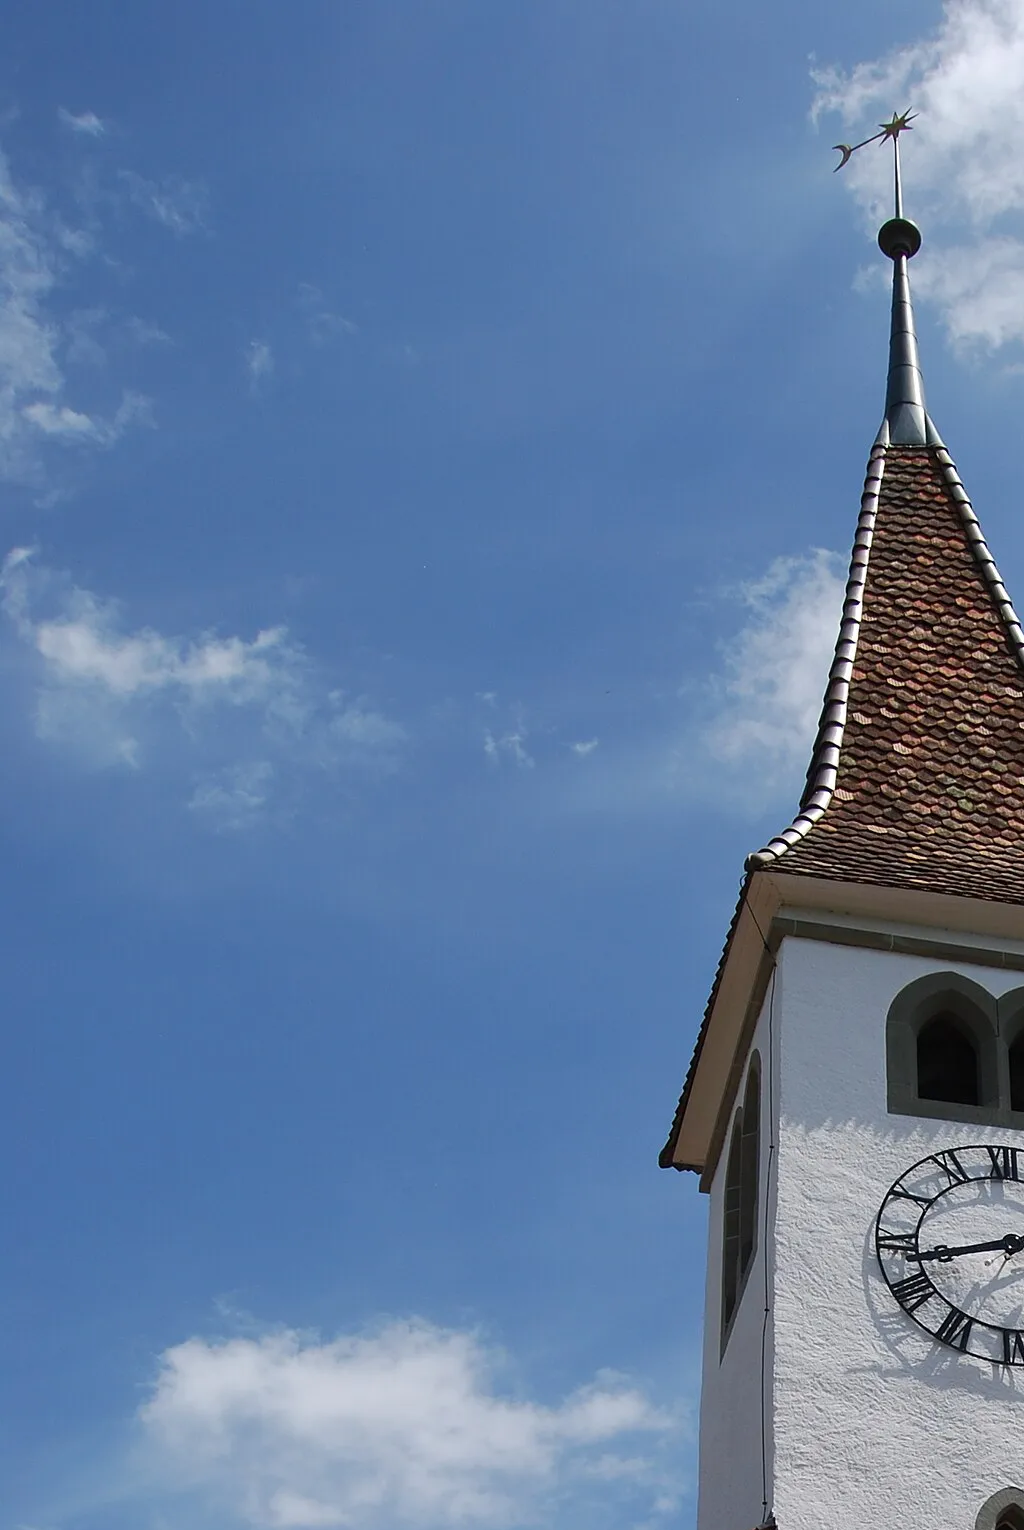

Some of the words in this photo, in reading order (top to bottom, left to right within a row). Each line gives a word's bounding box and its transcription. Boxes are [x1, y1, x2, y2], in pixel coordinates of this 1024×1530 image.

[932, 1151, 968, 1186] XI
[988, 1146, 1018, 1180] XII
[889, 1182, 934, 1211] X
[878, 1228, 917, 1251] IX
[892, 1273, 936, 1313] VIII
[936, 1310, 971, 1352] VII
